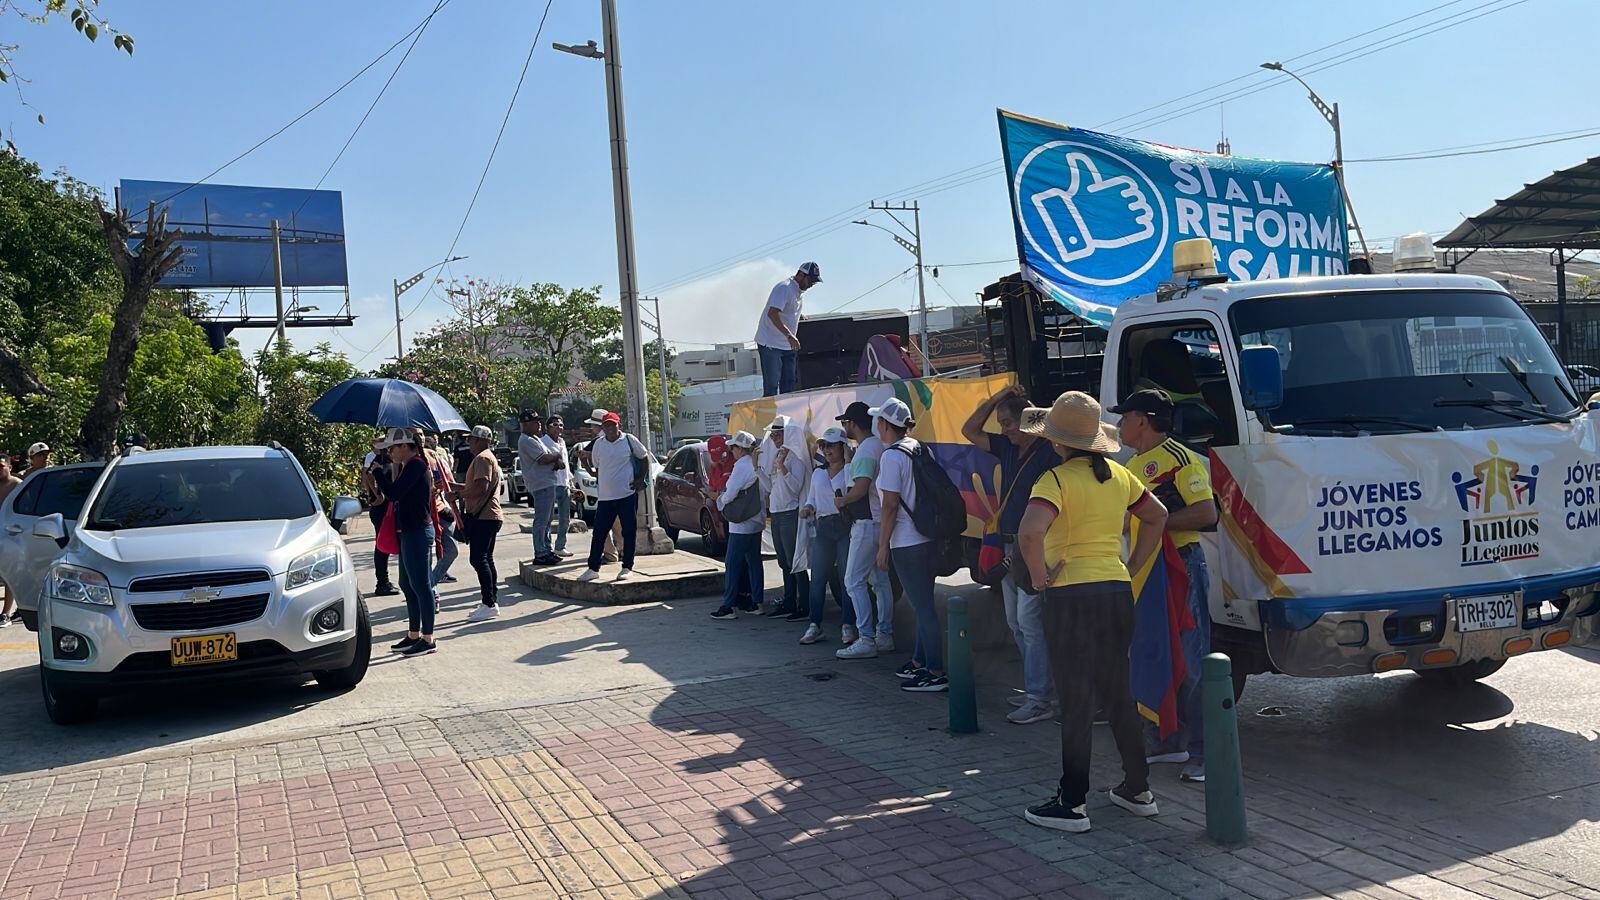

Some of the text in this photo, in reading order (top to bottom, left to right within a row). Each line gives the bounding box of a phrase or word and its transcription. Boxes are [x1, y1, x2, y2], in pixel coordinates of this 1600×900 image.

[1225, 178, 1249, 203] A
[1253, 180, 1293, 207] LA
[1175, 197, 1344, 255] REFORMA
[1317, 481, 1422, 507] JÓVENES
[1564, 487, 1595, 508] POR
[1318, 506, 1408, 532] JUNTOS
[1461, 515, 1539, 545] Juntos
[1566, 508, 1600, 530] CAM
[1319, 527, 1443, 556] LLEGAMOS
